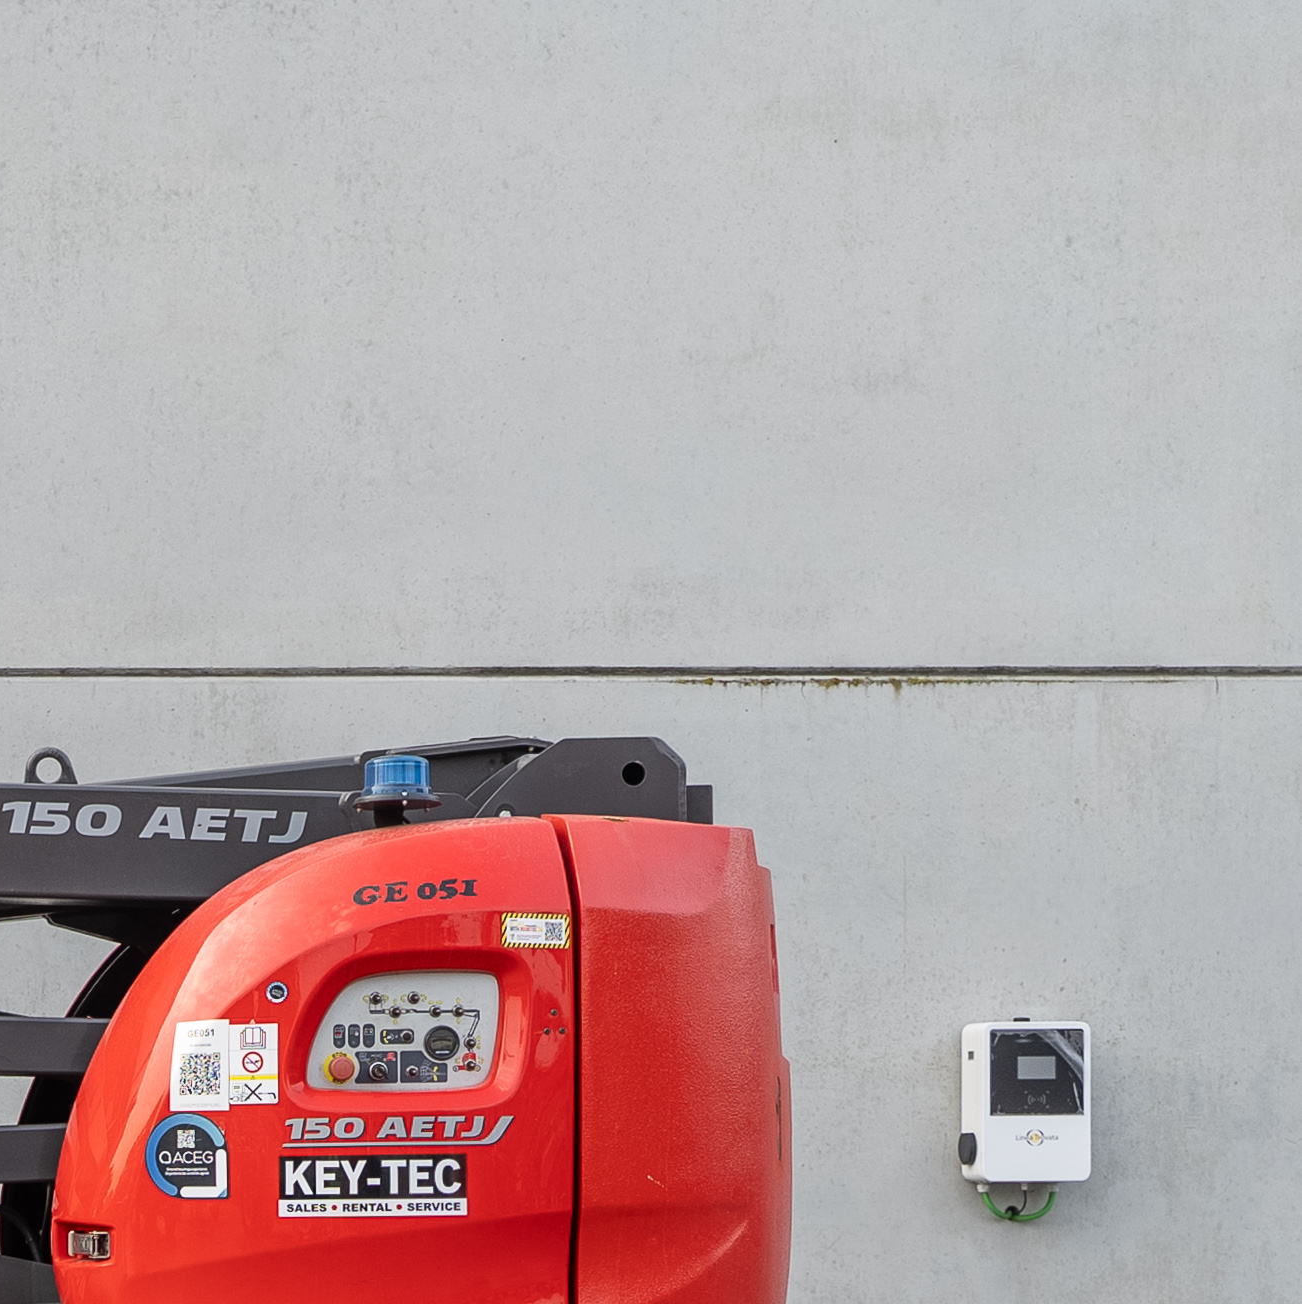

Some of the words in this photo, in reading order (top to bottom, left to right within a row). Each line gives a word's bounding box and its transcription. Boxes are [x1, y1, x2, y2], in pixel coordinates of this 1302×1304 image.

[1, 801, 123, 837] 150
[138, 806, 308, 843] AETJ
[353, 881, 408, 906] GE
[417, 878, 478, 900] 051
[187, 1028, 215, 1037] GE051
[284, 1117, 366, 1140] 150
[376, 1115, 486, 1139] AETJ
[284, 1158, 462, 1195] KEY-TEC
[286, 1203, 327, 1213] SALES
[342, 1203, 392, 1212] RENTAL
[407, 1202, 461, 1211] SERVICE
